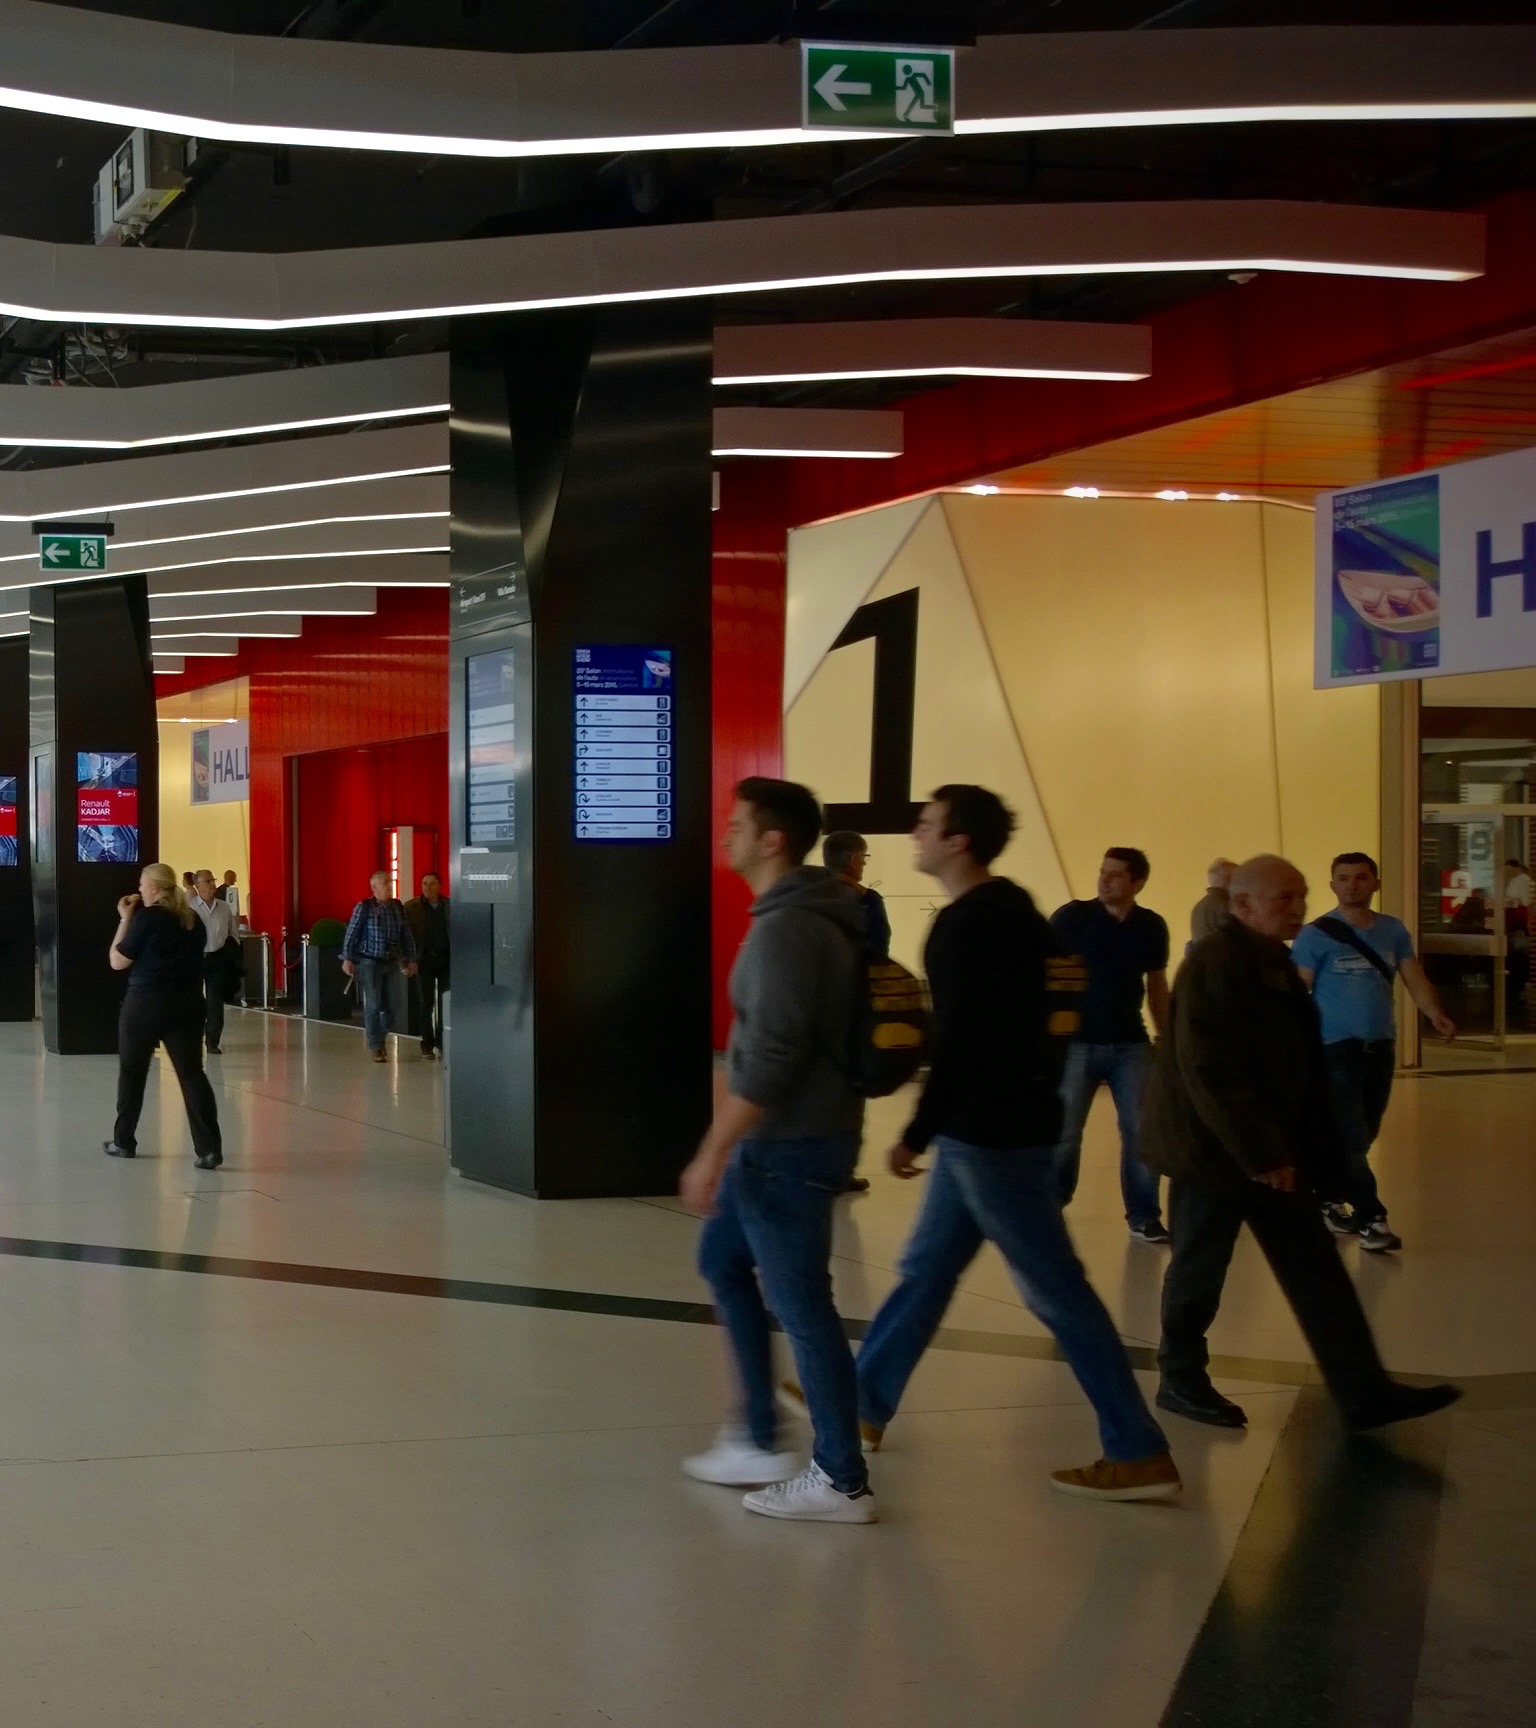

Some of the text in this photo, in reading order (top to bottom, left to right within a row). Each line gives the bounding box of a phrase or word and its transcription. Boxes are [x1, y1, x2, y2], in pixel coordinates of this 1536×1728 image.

[822, 586, 942, 835] 1
[213, 746, 250, 784] HALL
[80, 799, 110, 808] Renault
[80, 808, 111, 816] KADJAR
